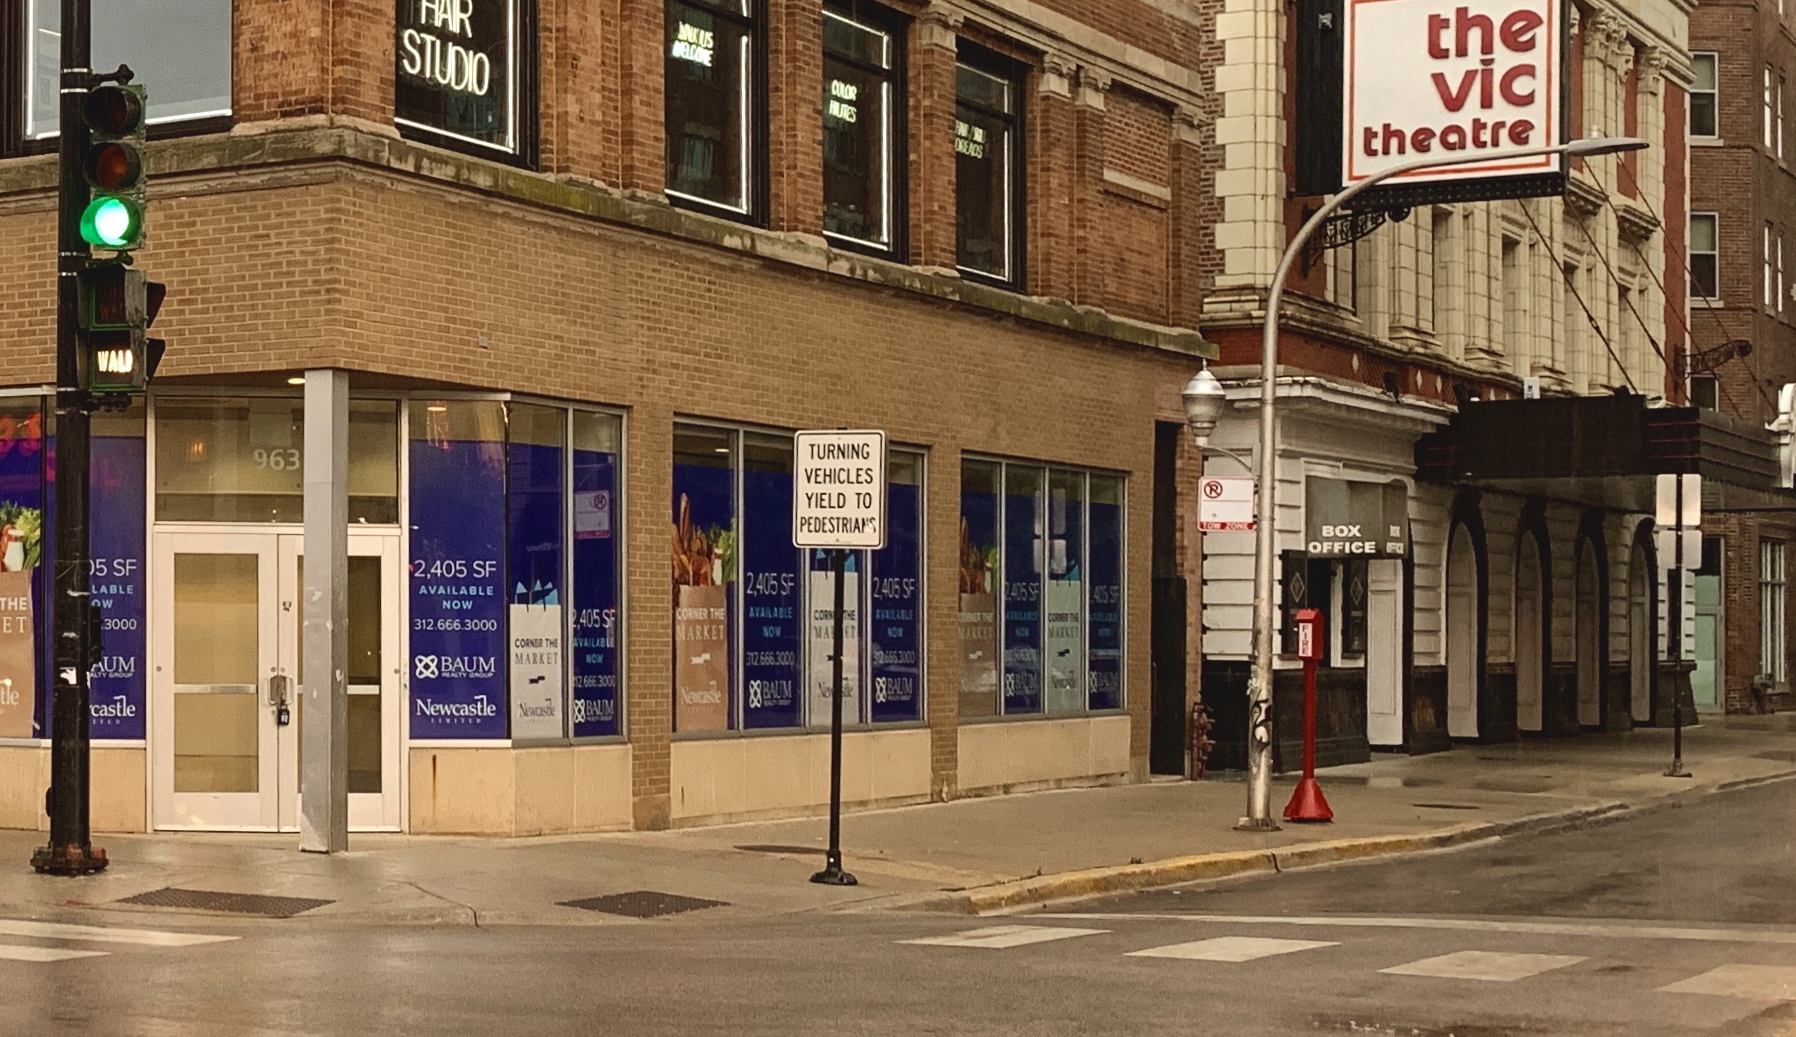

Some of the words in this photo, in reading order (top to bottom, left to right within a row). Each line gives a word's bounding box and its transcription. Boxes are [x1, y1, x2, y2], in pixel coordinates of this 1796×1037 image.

[1427, 6, 1544, 60] the
[402, 28, 490, 96] STUDIO
[831, 78, 857, 102] COLOR
[1430, 57, 1536, 112] vic
[828, 99, 857, 123] HILITES
[1363, 118, 1535, 157] theatre
[252, 448, 301, 471] 963
[808, 442, 870, 460] TURNING
[804, 467, 874, 484] VEHICLES
[805, 492, 846, 509] YIELD
[855, 492, 872, 509] TO
[1202, 522, 1221, 530] TOW
[1225, 522, 1249, 530] ZONE
[1321, 524, 1362, 538] BOX
[1308, 541, 1377, 554] OFFICE
[113, 559, 137, 576] SF
[414, 559, 467, 580] 2,405
[472, 560, 497, 578] SF
[419, 585, 494, 595] AVAILABLE
[746, 572, 778, 597] 2,405
[780, 572, 795, 595] SF
[873, 577, 900, 600] 2,405
[902, 578, 915, 599] SF
[0, 597, 27, 611] THE
[442, 600, 473, 610] NOW
[749, 606, 793, 619] AVAILABLE
[572, 609, 600, 631] 2,405
[602, 609, 616, 628] SF
[676, 607, 708, 620] CORNER
[709, 607, 725, 620] THE
[414, 619, 497, 631] 312.666.3000
[676, 624, 724, 640] MARKET
[762, 626, 782, 638] NOW
[1048, 626, 1079, 639] MARKET
[515, 638, 543, 648] CORNER
[545, 638, 558, 648] THE
[572, 637, 614, 648] AVAILABLE
[91, 656, 135, 673] AUM
[441, 656, 496, 673] BAUM
[515, 652, 558, 665] MARKET
[585, 654, 603, 664] NOW
[746, 651, 795, 666] 312.666.3000
[763, 680, 792, 699] BAUM
[887, 678, 913, 695] BAUM
[90, 695, 136, 717] castle
[416, 695, 497, 716] Newcastle
[519, 698, 555, 718] Newcastle
[585, 699, 614, 716] BAUM
